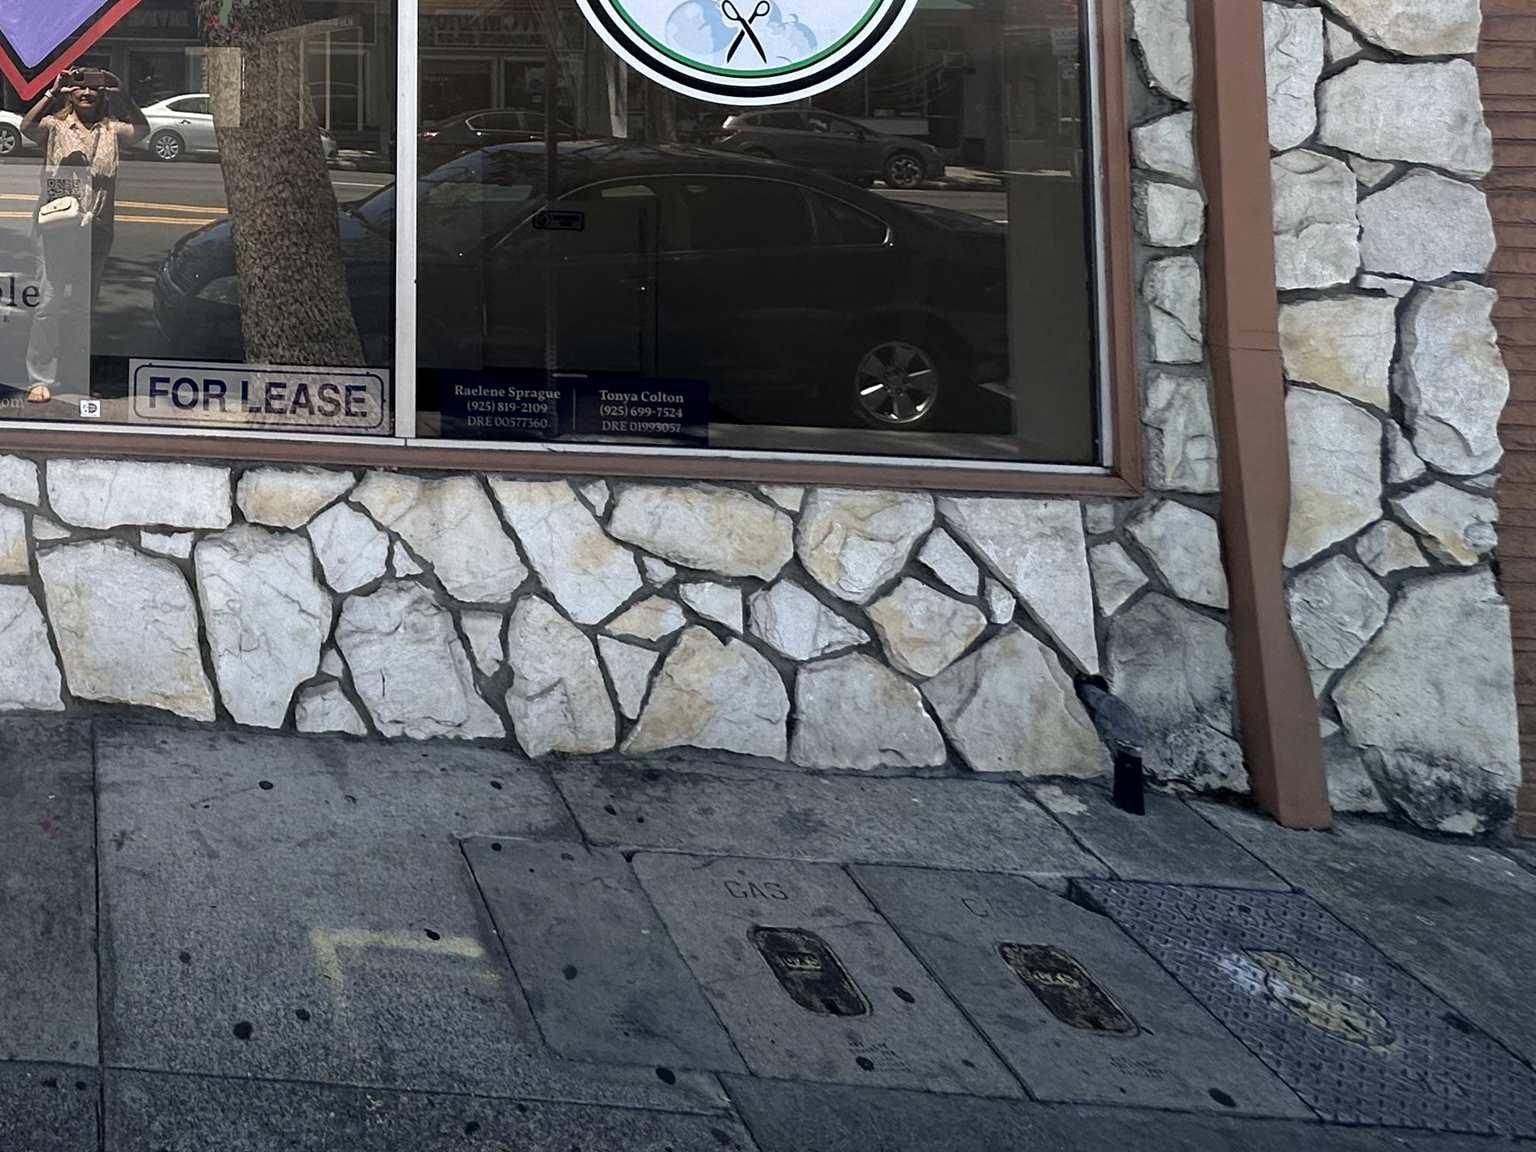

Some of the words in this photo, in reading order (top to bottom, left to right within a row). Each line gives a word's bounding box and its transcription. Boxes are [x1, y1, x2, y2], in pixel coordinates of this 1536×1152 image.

[148, 375, 228, 414] FOR
[242, 377, 368, 419] LEASE
[454, 384, 506, 398] Raelene
[508, 385, 561, 401] Sprague
[599, 389, 639, 404] Tonya
[640, 391, 684, 404] Colton
[466, 400, 496, 414] (925)
[497, 401, 549, 414] 819-2109
[599, 404, 629, 418] (925)
[467, 415, 493, 428] DRE
[601, 420, 628, 432] DRE
[724, 879, 789, 901] GAS
